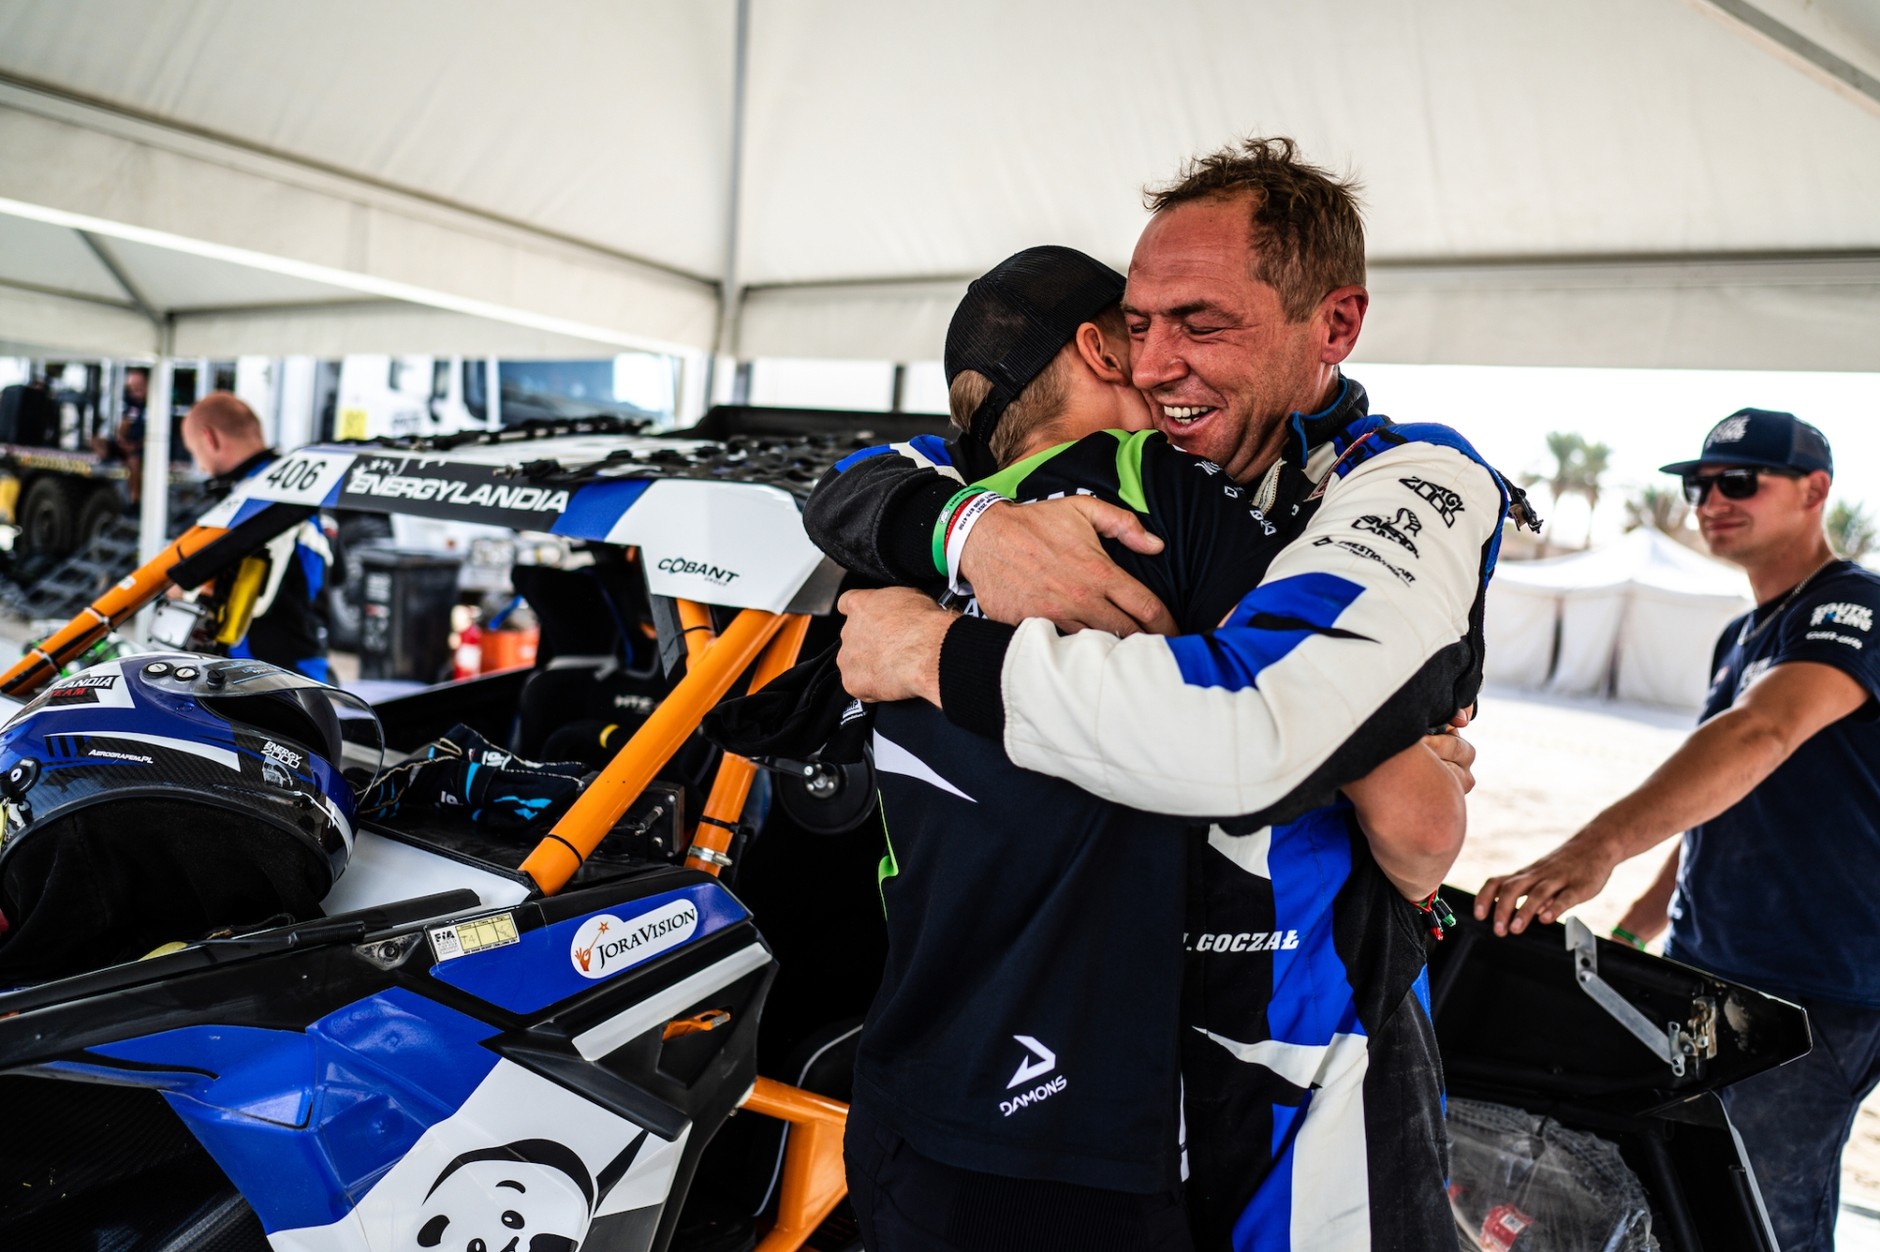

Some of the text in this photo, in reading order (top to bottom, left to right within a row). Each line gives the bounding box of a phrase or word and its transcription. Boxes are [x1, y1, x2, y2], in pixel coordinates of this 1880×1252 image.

[267, 459, 327, 491] 406
[346, 474, 569, 513] ENERGYLANDIA
[657, 557, 740, 583] COBANT
[261, 746, 300, 769] 2000
[263, 741, 302, 761] ENERGY
[999, 1075, 1067, 1117] DAMONS
